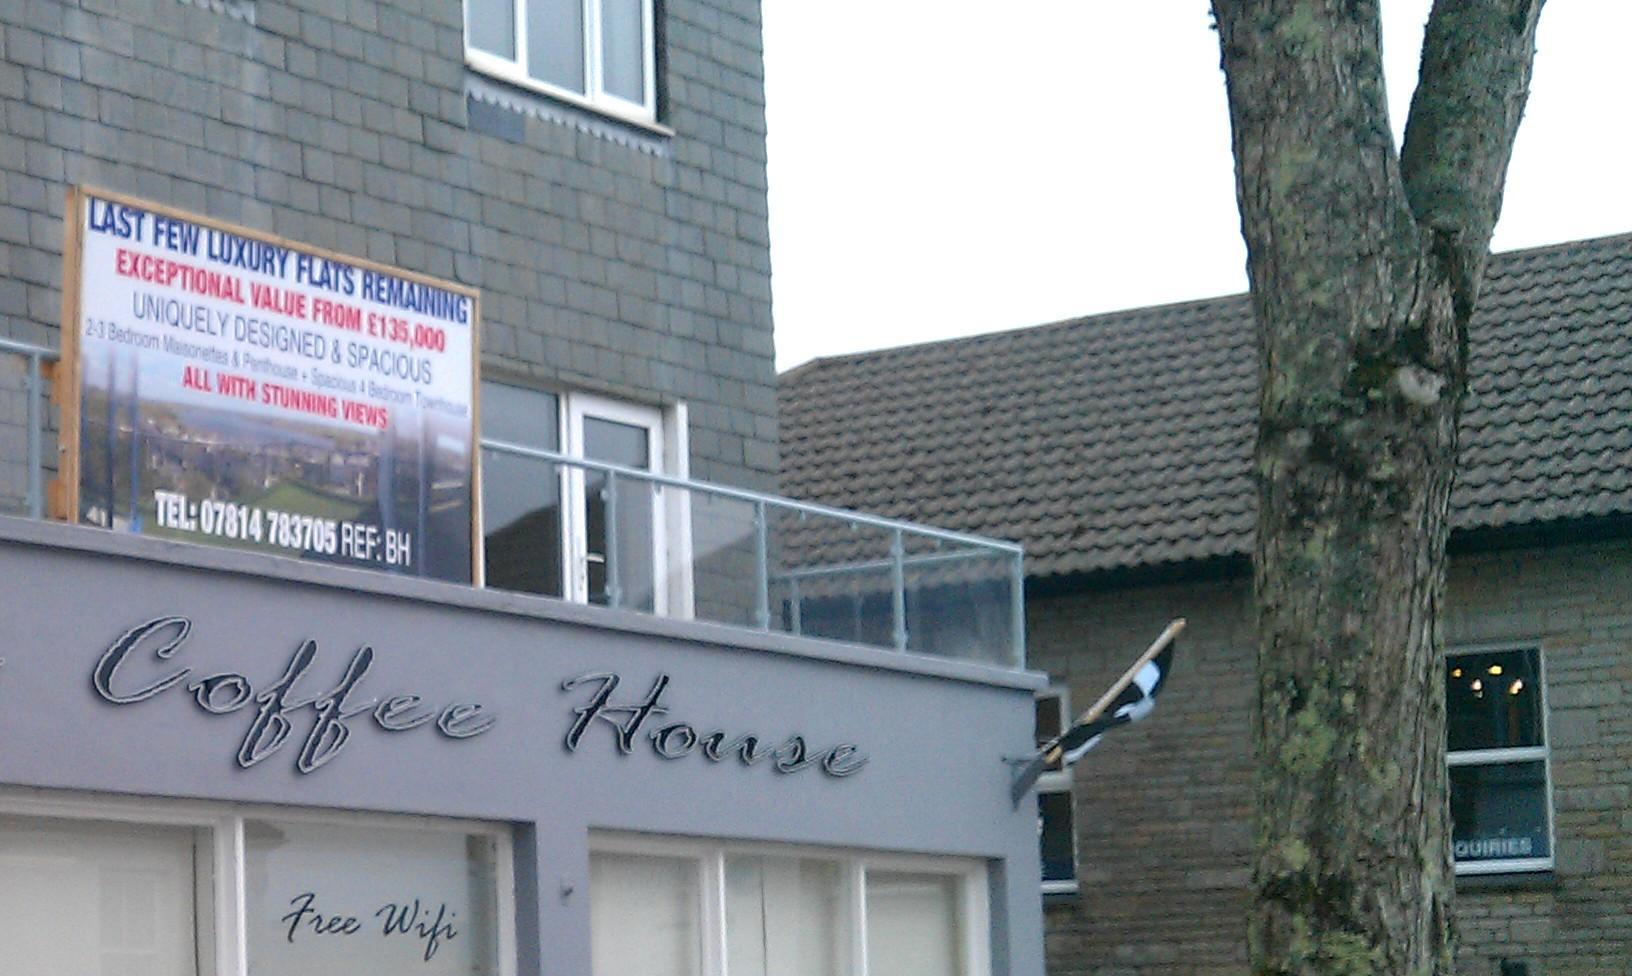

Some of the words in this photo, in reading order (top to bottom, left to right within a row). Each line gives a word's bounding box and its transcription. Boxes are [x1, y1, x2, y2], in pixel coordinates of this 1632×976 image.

[88, 196, 145, 242] LAST
[153, 215, 199, 255] FEW
[207, 229, 288, 281] LUXURY
[296, 253, 354, 296] FLATS
[363, 270, 468, 324] REMAINING
[115, 248, 245, 305] EXCEPTIONAL
[250, 283, 305, 320] VALUE
[312, 297, 361, 331] FROM
[368, 311, 445, 353] £135,000
[87, 318, 104, 339] 2-3
[109, 324, 159, 349] Bedroom
[232, 351, 239, 368] &
[243, 353, 297, 380] Penthouse
[311, 367, 356, 392] Spacious
[369, 381, 412, 406] Bedroom
[133, 291, 228, 336] UNIQUELY
[235, 316, 325, 360] DESIGNED
[331, 339, 341, 363] &
[347, 343, 432, 385] SPACIOUS
[183, 365, 211, 392] ALL
[217, 372, 256, 400] WITH
[262, 384, 337, 418] STUNNING
[342, 400, 388, 429] VIEWS
[155, 491, 196, 531] TEL:
[201, 500, 261, 542] 07814
[268, 511, 337, 555] 783705
[342, 521, 382, 560] REF:
[386, 532, 411, 566] BH
[92, 614, 498, 776] Coffee
[557, 671, 871, 778] House
[1456, 837, 1532, 857] QUIRIES
[282, 892, 362, 943] Free
[374, 899, 459, 963] Wifi
